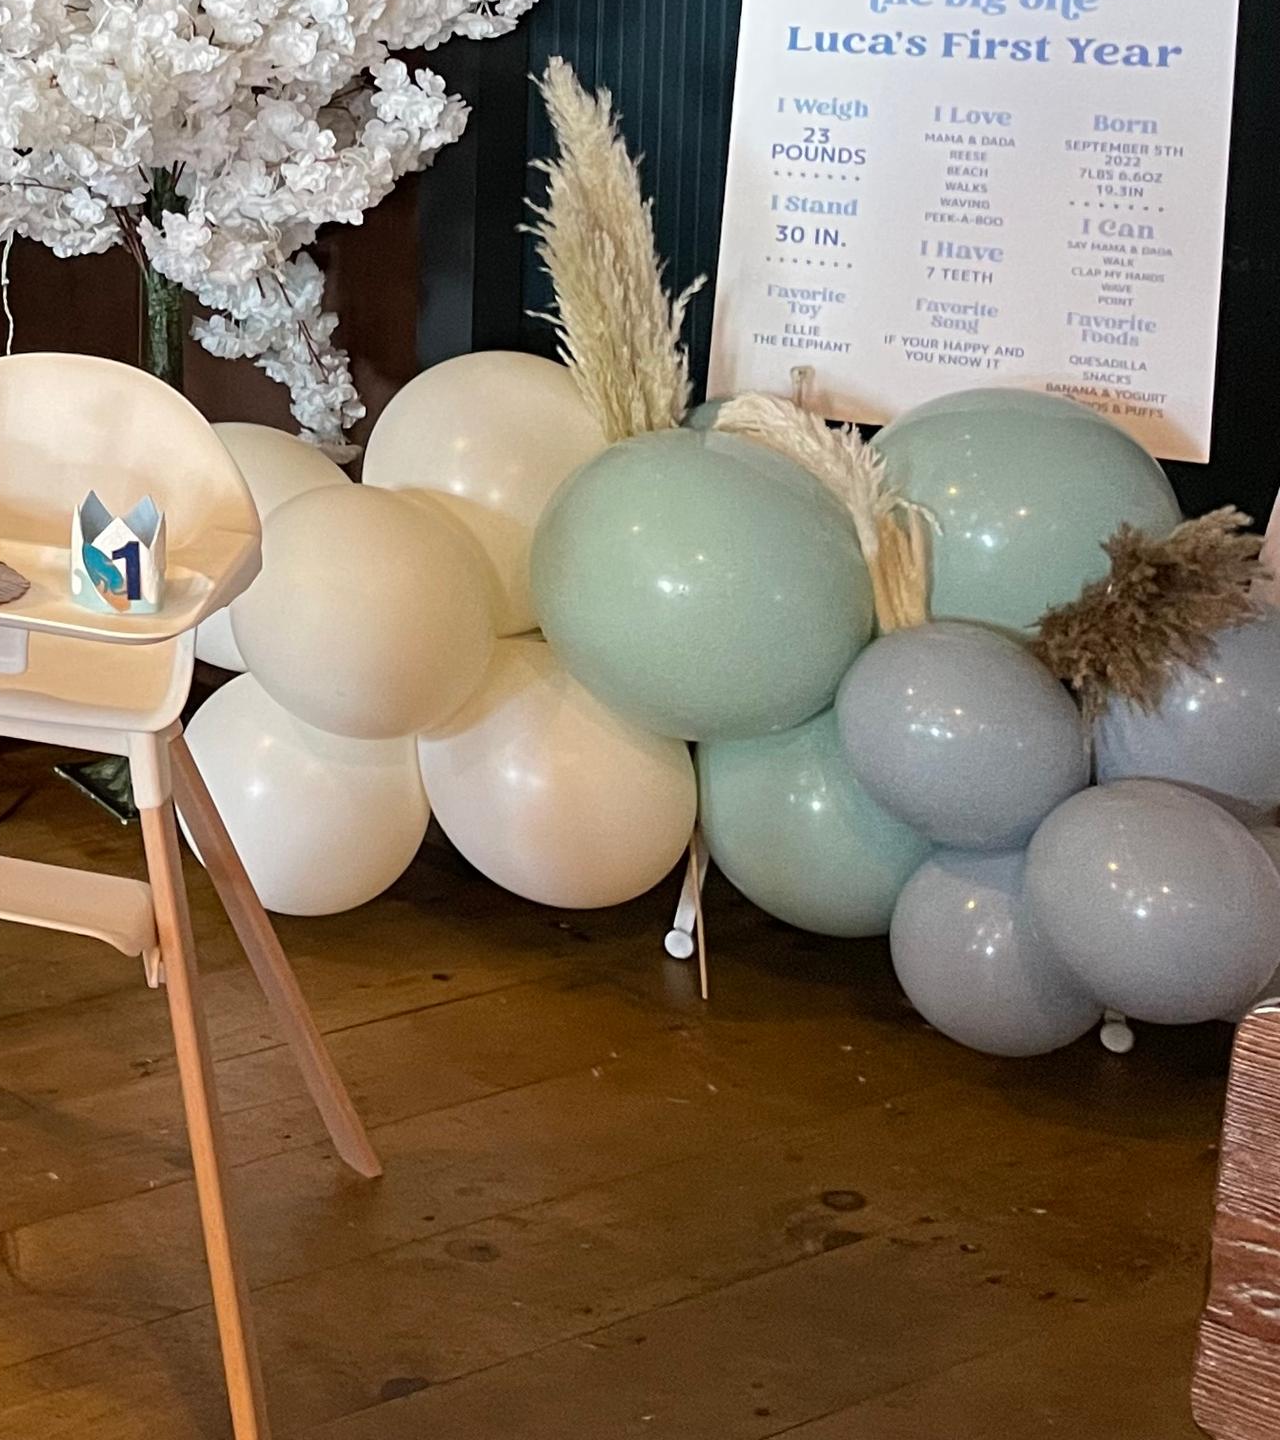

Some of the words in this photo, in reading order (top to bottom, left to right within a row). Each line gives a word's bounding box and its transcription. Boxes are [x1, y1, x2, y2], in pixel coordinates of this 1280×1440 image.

[787, 26, 927, 57] Luca's
[941, 29, 1051, 62] First
[1067, 37, 1183, 68] Year
[777, 97, 785, 113] I
[793, 96, 869, 121] Weigh
[934, 106, 942, 122] I
[949, 107, 1012, 126] Love
[1093, 114, 1158, 134] Born
[803, 127, 830, 144] 23
[924, 132, 964, 144] MAMA
[981, 136, 1016, 148] DADA
[772, 143, 867, 165] POUNDS
[949, 150, 987, 161] REESE
[1064, 139, 1149, 155] SEPTEMBER
[1154, 144, 1184, 158] 5TH
[1105, 154, 1141, 167] 2022
[947, 166, 989, 177] BEACH
[945, 181, 988, 193] WALKS
[771, 194, 778, 210] I
[784, 195, 858, 216] Stand
[940, 197, 991, 210] WAVING
[924, 212, 1004, 227] PEEK-A-BOO
[1082, 218, 1091, 235] I
[1098, 219, 1154, 239] Can
[776, 224, 805, 243] 30
[814, 228, 846, 247] IN.
[920, 240, 928, 256] I
[936, 241, 1004, 262] Have
[1103, 257, 1135, 268] WALK
[926, 266, 935, 279] 7
[942, 268, 993, 284] TEETH
[1071, 267, 1102, 277] CLAP
[1104, 270, 1122, 279] MY
[1125, 272, 1165, 283] HANDS
[767, 283, 846, 303] Favorite
[1098, 296, 1134, 307] POINT
[787, 301, 822, 319] Toy
[915, 297, 999, 318] Favorite
[784, 323, 820, 336] ELLIE
[930, 315, 980, 335] Song
[1066, 311, 1157, 333] Favorite
[753, 333, 778, 345] THE
[782, 336, 851, 353] ELEPHANT
[884, 334, 897, 345] IF
[901, 336, 939, 349] YOUR
[943, 339, 990, 354] HAPPY
[994, 346, 1025, 358] AND
[1081, 329, 1139, 347] Foods
[905, 350, 934, 363] YOU
[938, 353, 982, 368] KNOW
[987, 358, 1001, 369] IT
[1068, 354, 1147, 371] QUESADILLA
[1082, 371, 1132, 385] SNACKS
[1046, 383, 1098, 397] BANANA
[1115, 389, 1167, 404] YOGURT
[111, 541, 141, 601] 1
